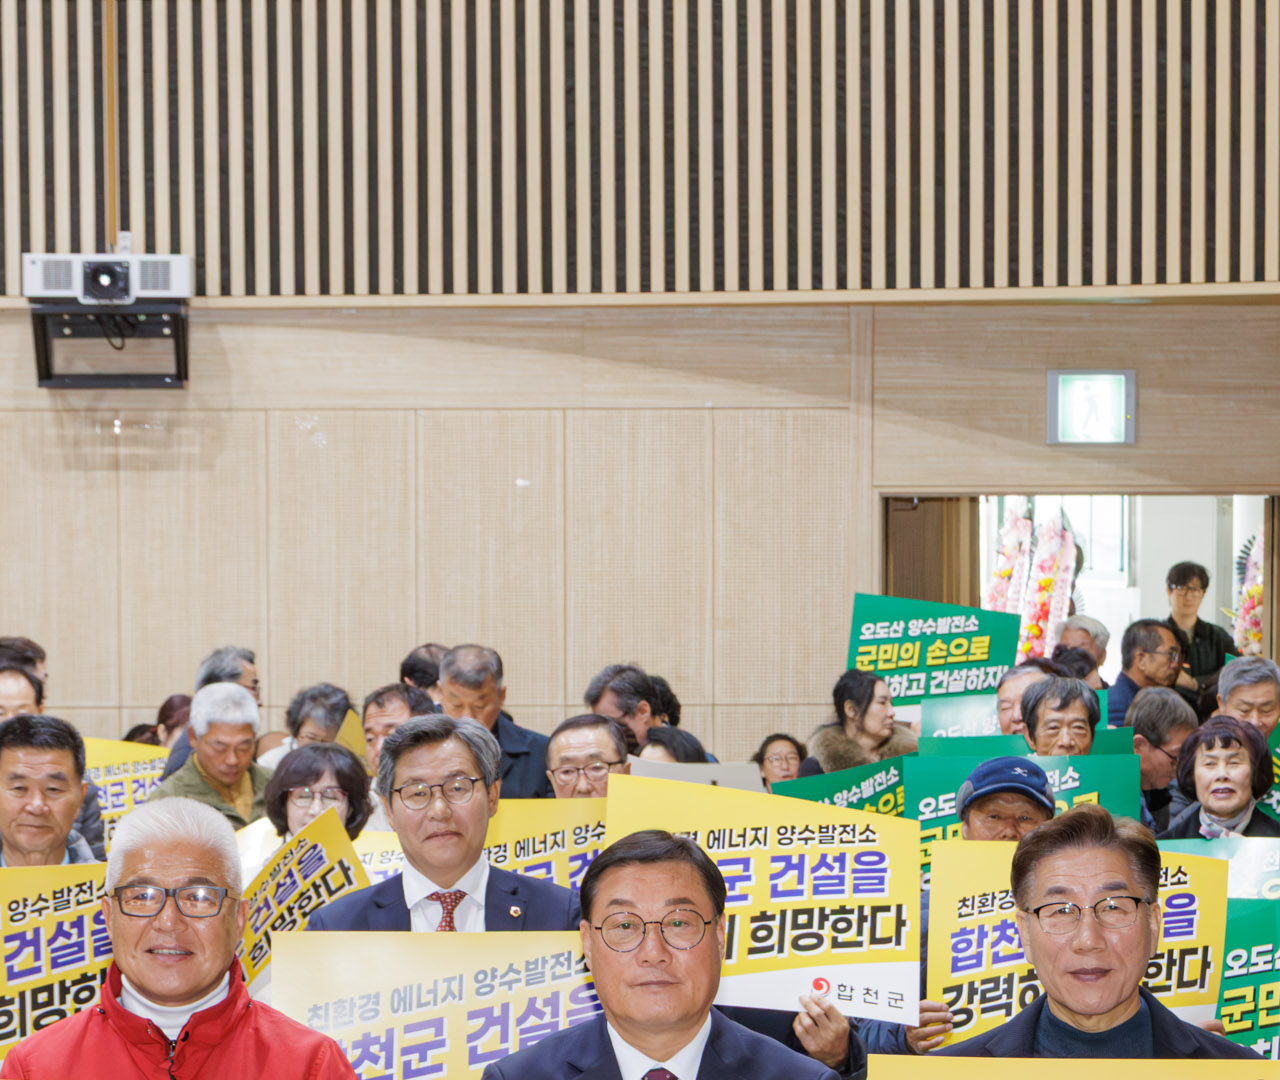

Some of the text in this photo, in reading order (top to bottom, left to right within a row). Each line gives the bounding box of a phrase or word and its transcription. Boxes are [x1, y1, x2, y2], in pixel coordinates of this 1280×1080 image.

[860, 615, 980, 641] 오도산 양수발전소
[856, 635, 991, 672] 군민의 손으로
[833, 766, 900, 803] 양수발전소
[514, 831, 567, 859] 에너지
[707, 824, 878, 850] 에너지 양수발전소
[248, 842, 329, 938] 건설을
[770, 851, 889, 900] 건설을
[958, 890, 1017, 919] 친환경
[4, 909, 113, 983] 건설을
[748, 904, 910, 958] 희망한다
[308, 1002, 381, 1031] 친환경
[389, 973, 464, 1015] 에너지
